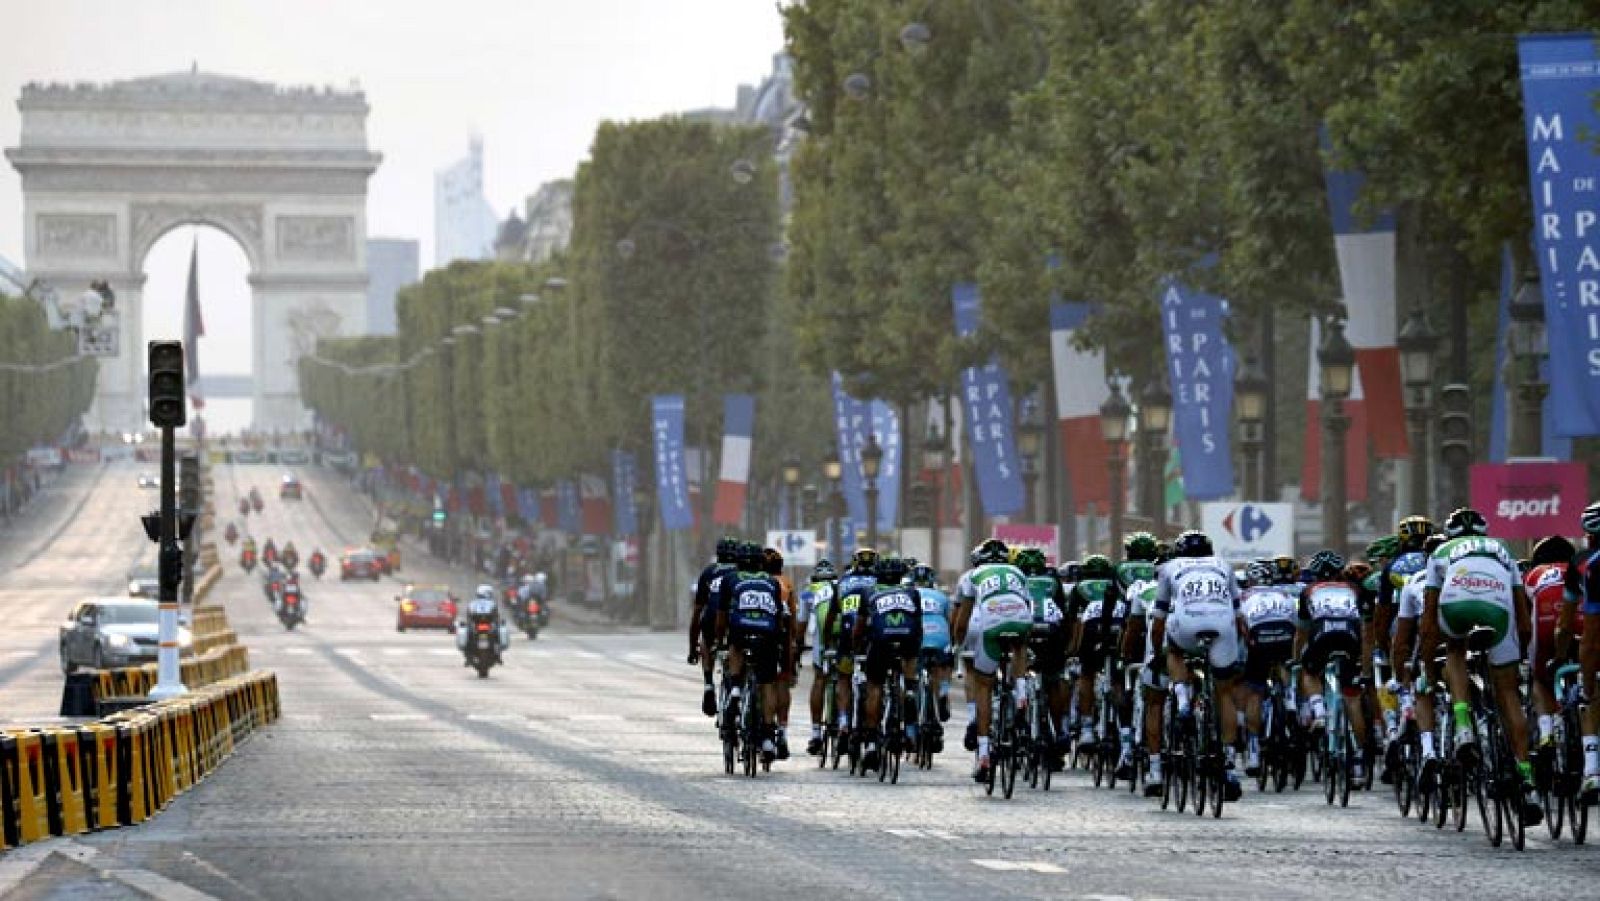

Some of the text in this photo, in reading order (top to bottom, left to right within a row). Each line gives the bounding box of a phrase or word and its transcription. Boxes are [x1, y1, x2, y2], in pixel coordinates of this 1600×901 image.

[1154, 285, 1188, 403] AIRIE
[1574, 210, 1600, 376] PARIS
[1192, 332, 1216, 454] PARIS
[1497, 494, 1561, 520] sport
